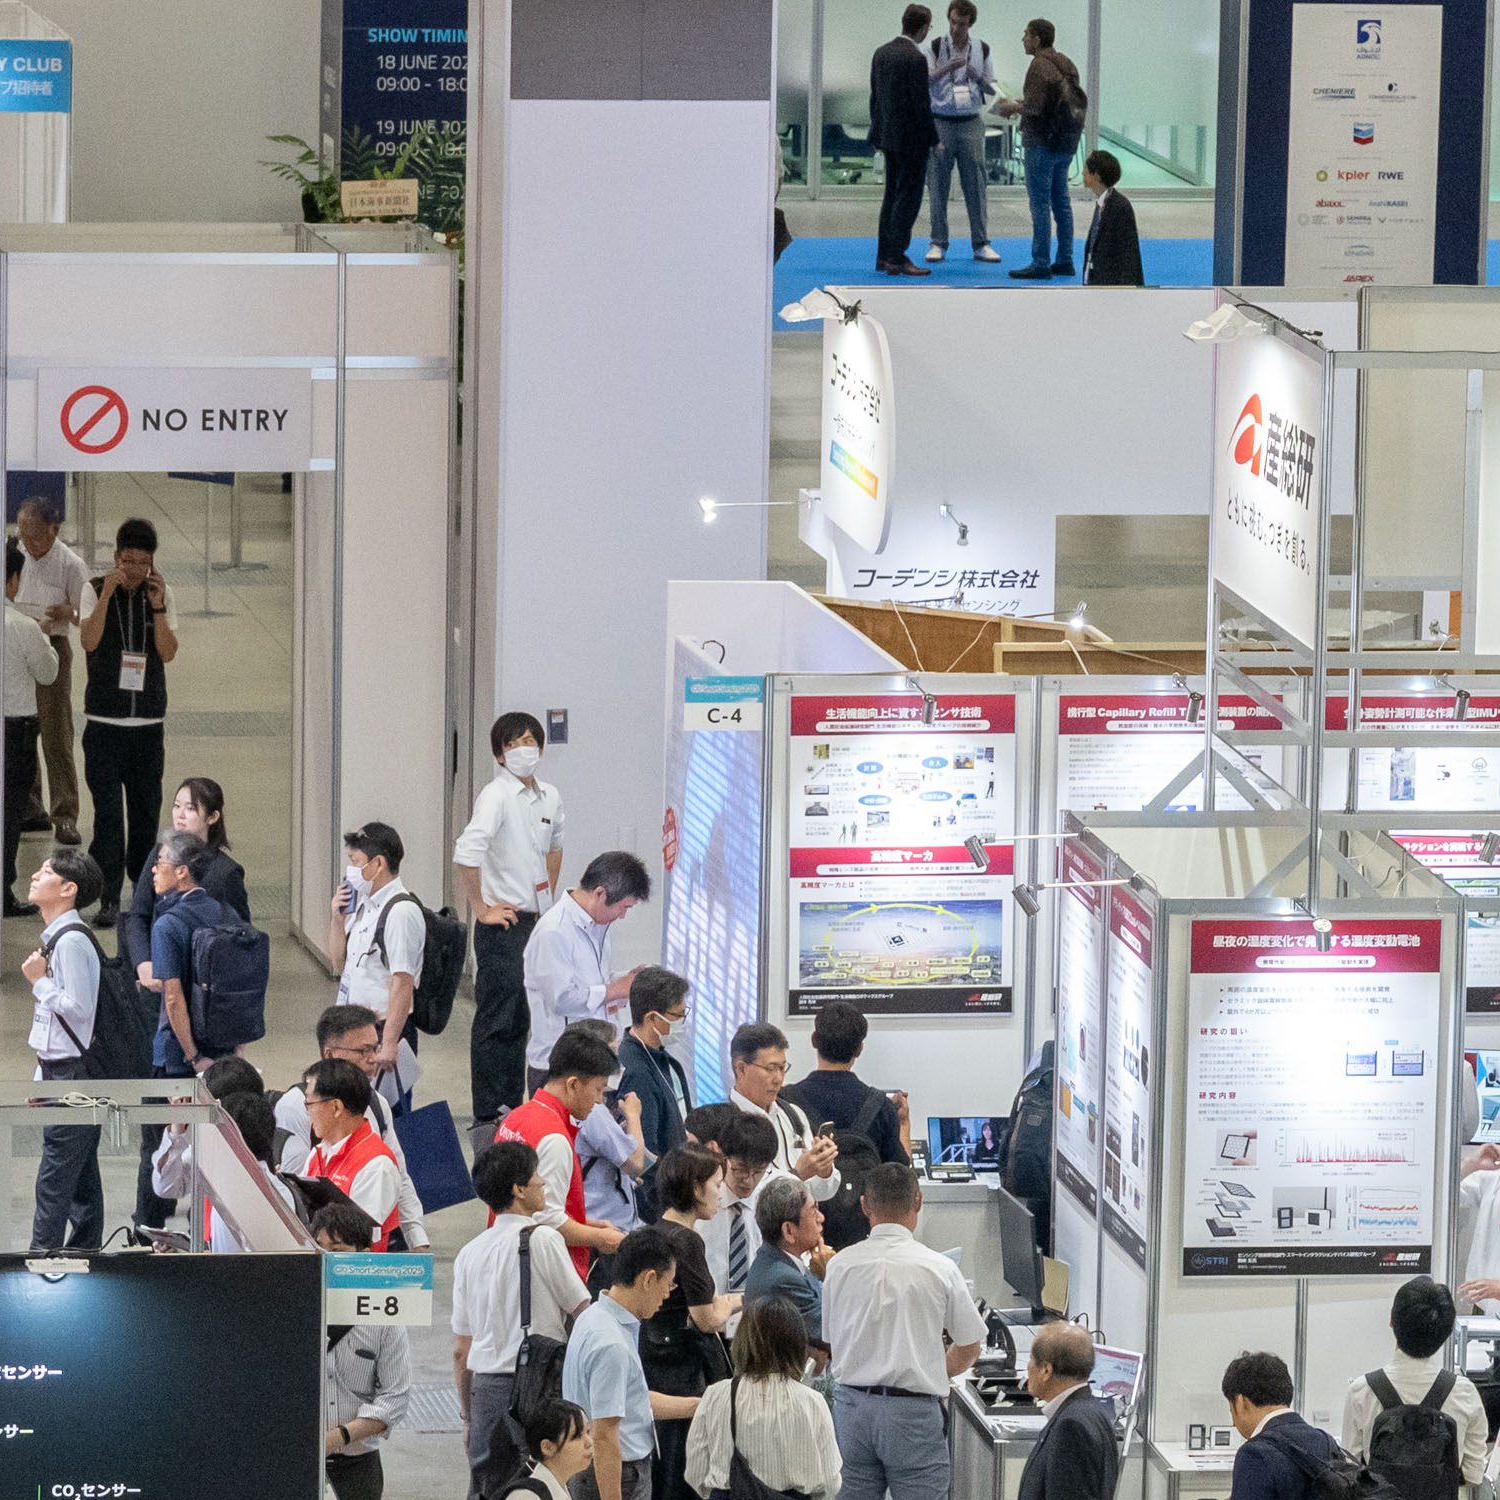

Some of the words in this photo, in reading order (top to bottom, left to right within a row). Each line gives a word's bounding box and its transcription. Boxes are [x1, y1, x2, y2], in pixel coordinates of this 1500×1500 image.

[368, 28, 418, 43] SHOW
[13, 57, 63, 73] CLUB
[377, 55, 396, 69] 18
[400, 55, 437, 70] JUNE
[376, 76, 420, 92] 09:00
[375, 120, 395, 135] 19
[398, 120, 436, 136] JUNE
[1337, 170, 1370, 182] kpler
[1378, 171, 1404, 180] RWE
[142, 408, 188, 432] NO
[202, 408, 289, 432] ENTRY
[1264, 412, 1315, 510] 産総研
[853, 567, 1040, 590] コーデンシ株式会社
[707, 708, 742, 723] C-4
[1098, 707, 1146, 719] Capillary
[1149, 707, 1176, 717] Refill
[1213, 935, 1420, 948] 昼夜の温度変化で発する温度変動電池
[372, 1266, 401, 1277] Sensing
[403, 1266, 423, 1275] 2025
[357, 1296, 399, 1316] E-8
